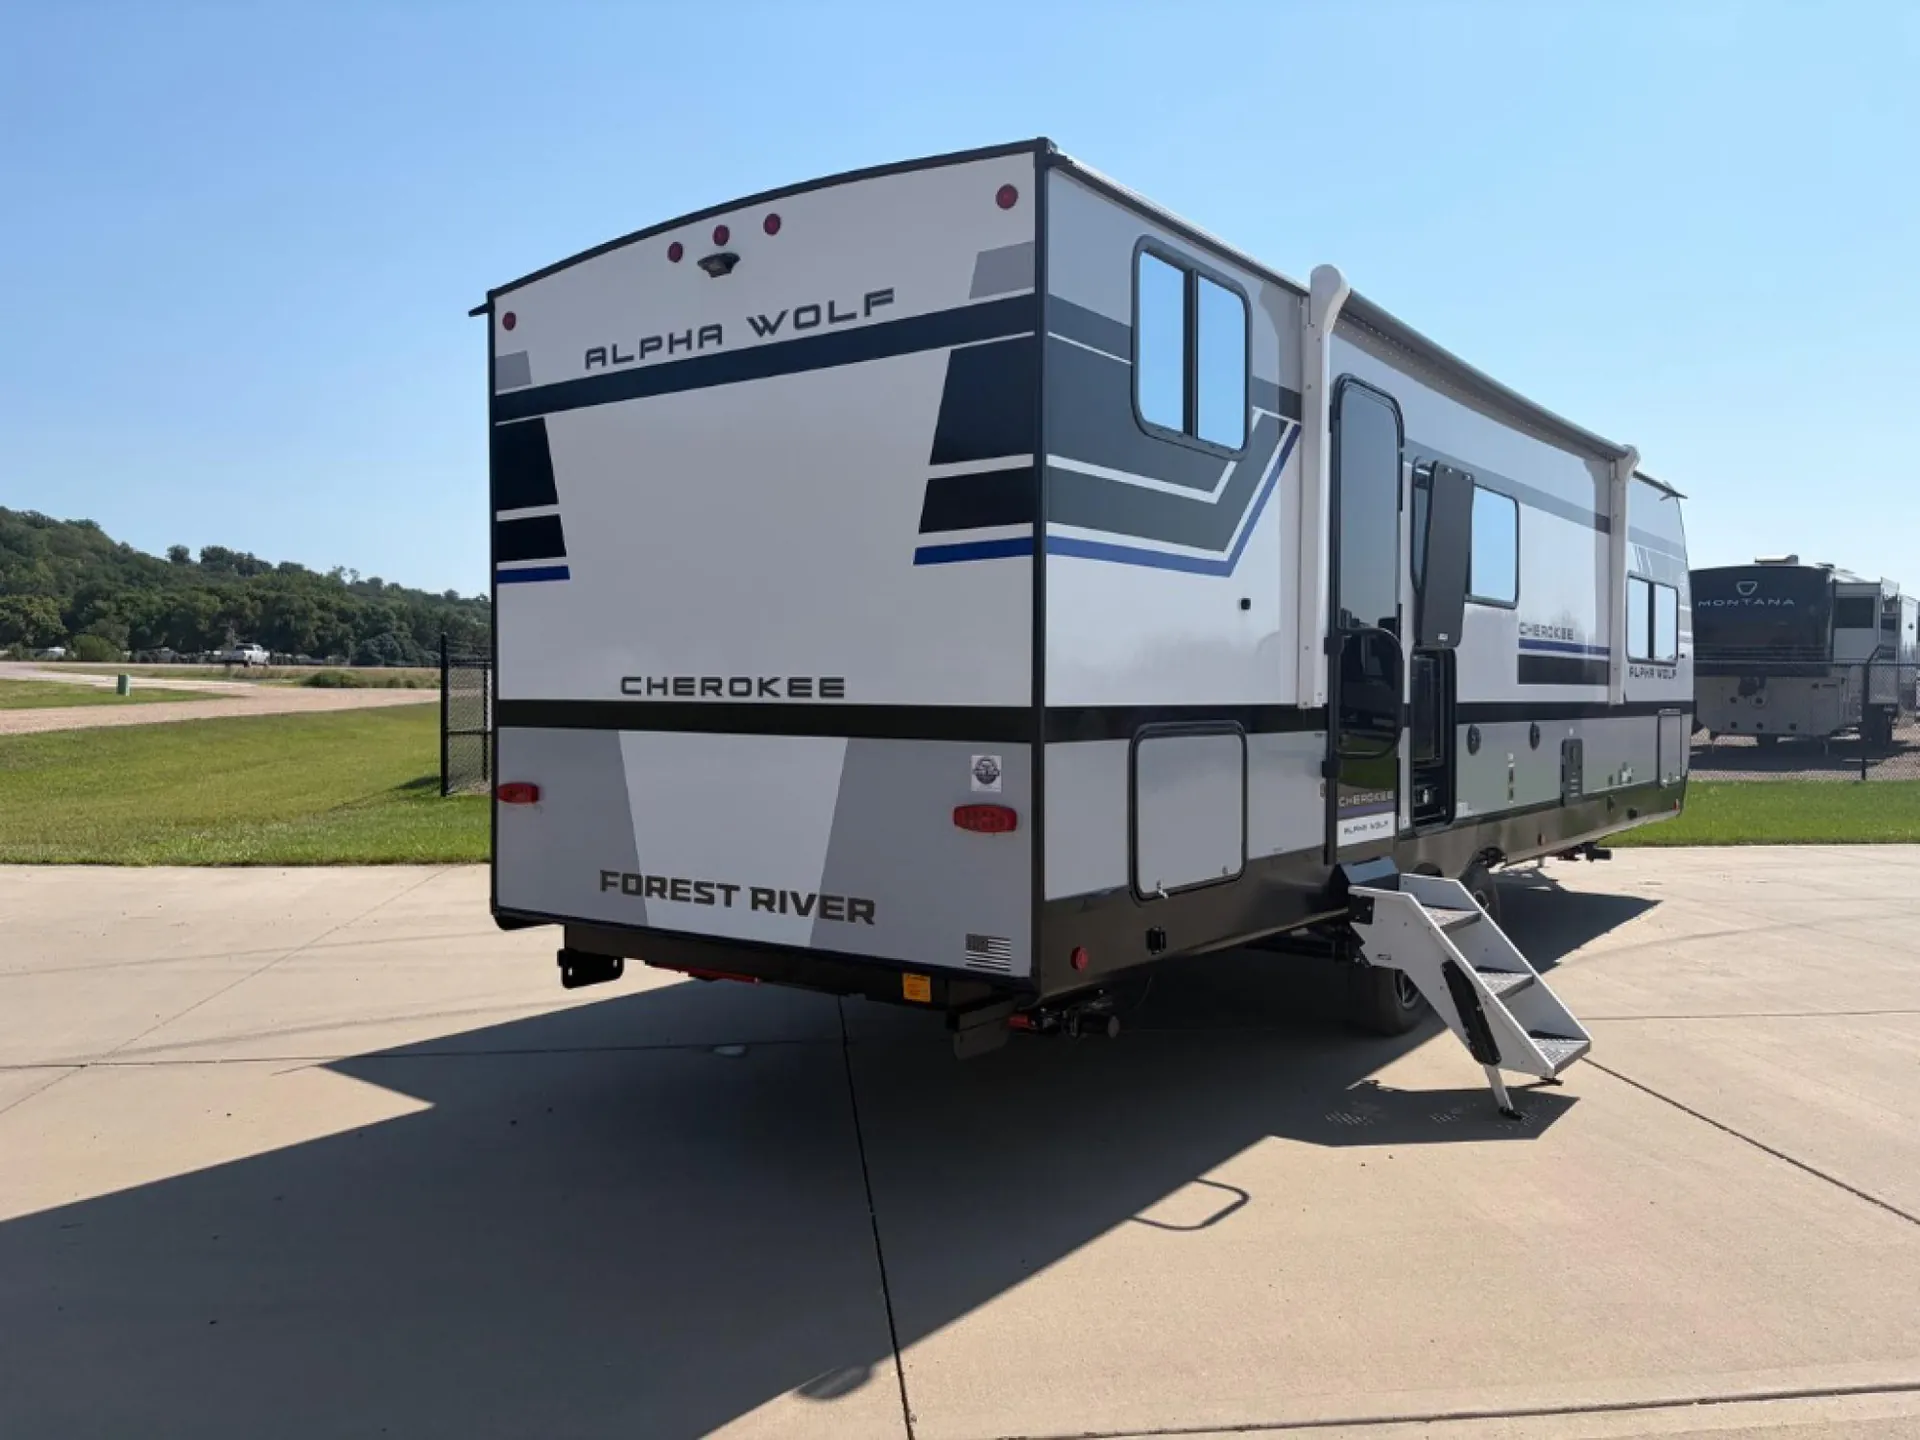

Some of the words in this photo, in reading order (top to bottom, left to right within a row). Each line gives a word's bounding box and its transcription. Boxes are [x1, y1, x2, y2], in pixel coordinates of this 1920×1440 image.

[585, 323, 723, 370] ALPHA
[746, 288, 895, 337] WOLF
[1698, 598, 1795, 607] MONTANA
[1519, 621, 1575, 641] CHEROKEE
[620, 676, 845, 698] CHEROKEE
[1339, 790, 1394, 807] CHEROKEE
[600, 870, 740, 908] FOREST
[750, 886, 875, 925] RIVER
